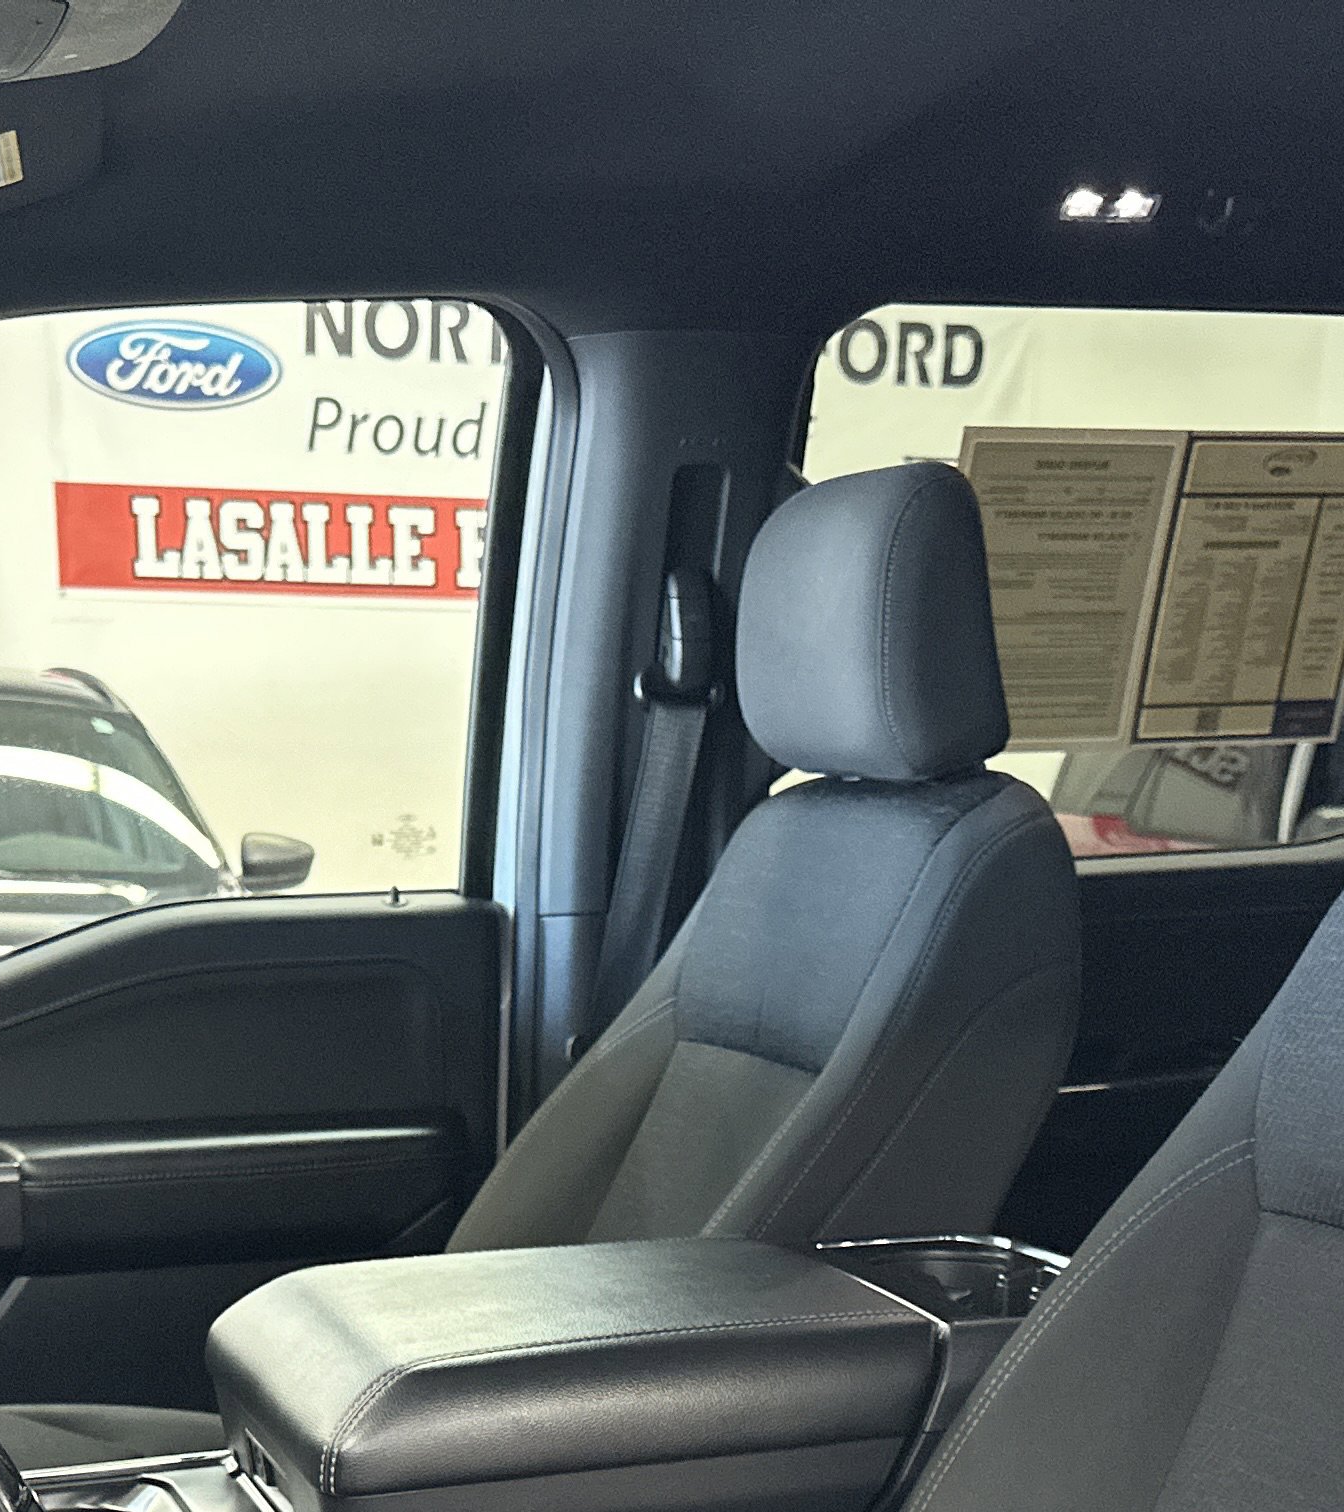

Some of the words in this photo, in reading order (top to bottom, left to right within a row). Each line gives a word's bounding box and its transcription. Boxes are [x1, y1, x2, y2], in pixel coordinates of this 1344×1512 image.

[105, 330, 244, 398] Ford
[838, 317, 984, 386] ORD
[308, 396, 488, 459] Proud
[130, 495, 438, 587] LASALLE
